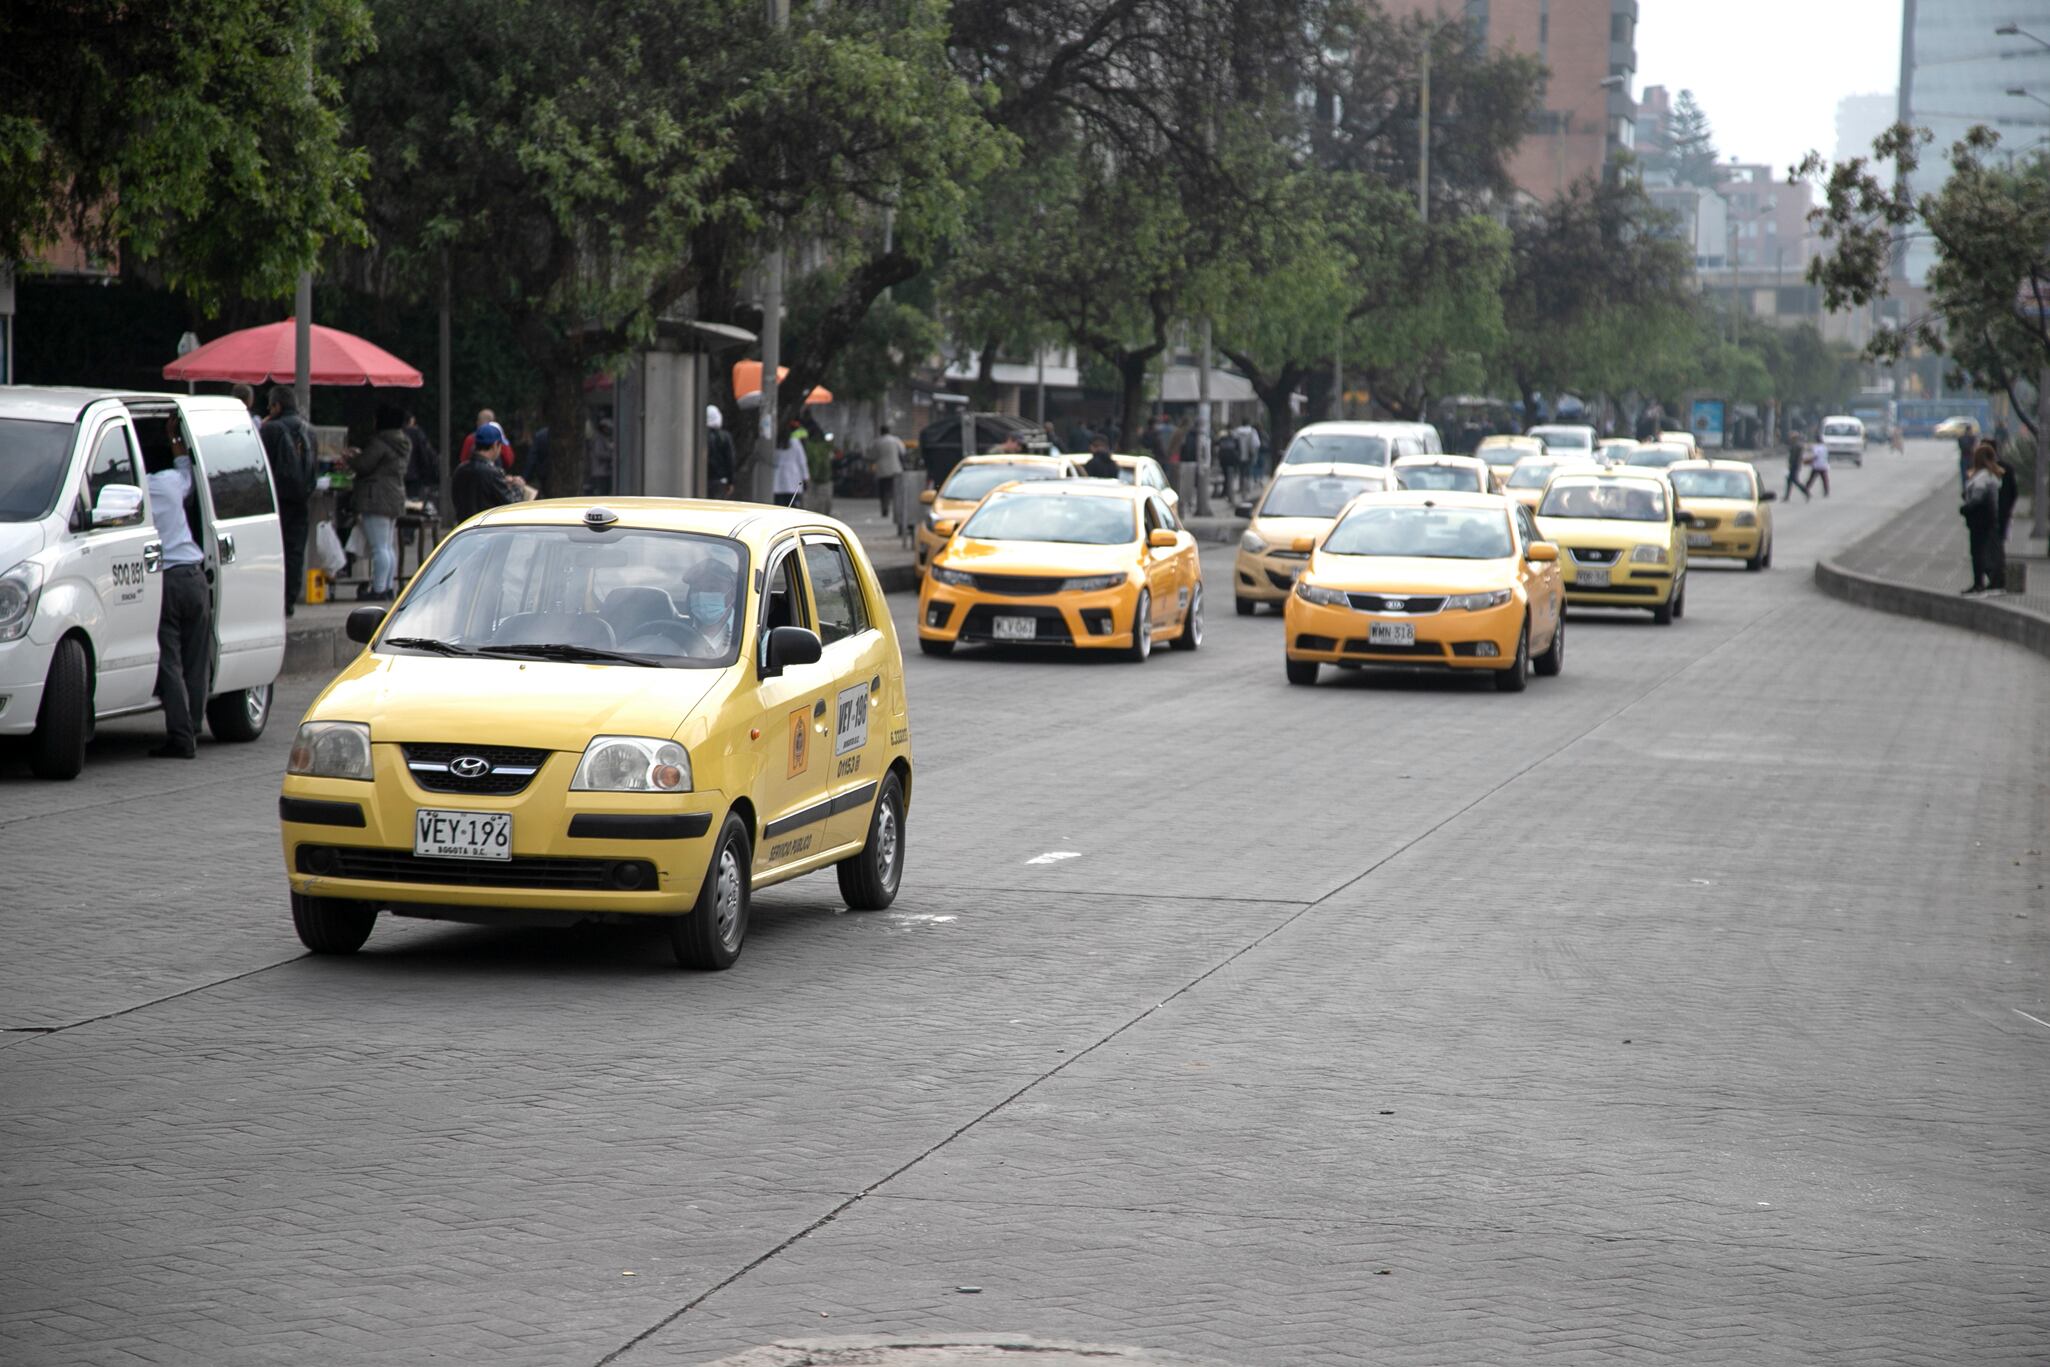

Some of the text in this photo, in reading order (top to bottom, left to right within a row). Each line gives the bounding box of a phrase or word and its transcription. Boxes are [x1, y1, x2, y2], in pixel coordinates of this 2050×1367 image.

[112, 561, 144, 586] SOQ 851
[437, 846, 468, 855] BOGOTA
[769, 841, 792, 861] SERVICIO
